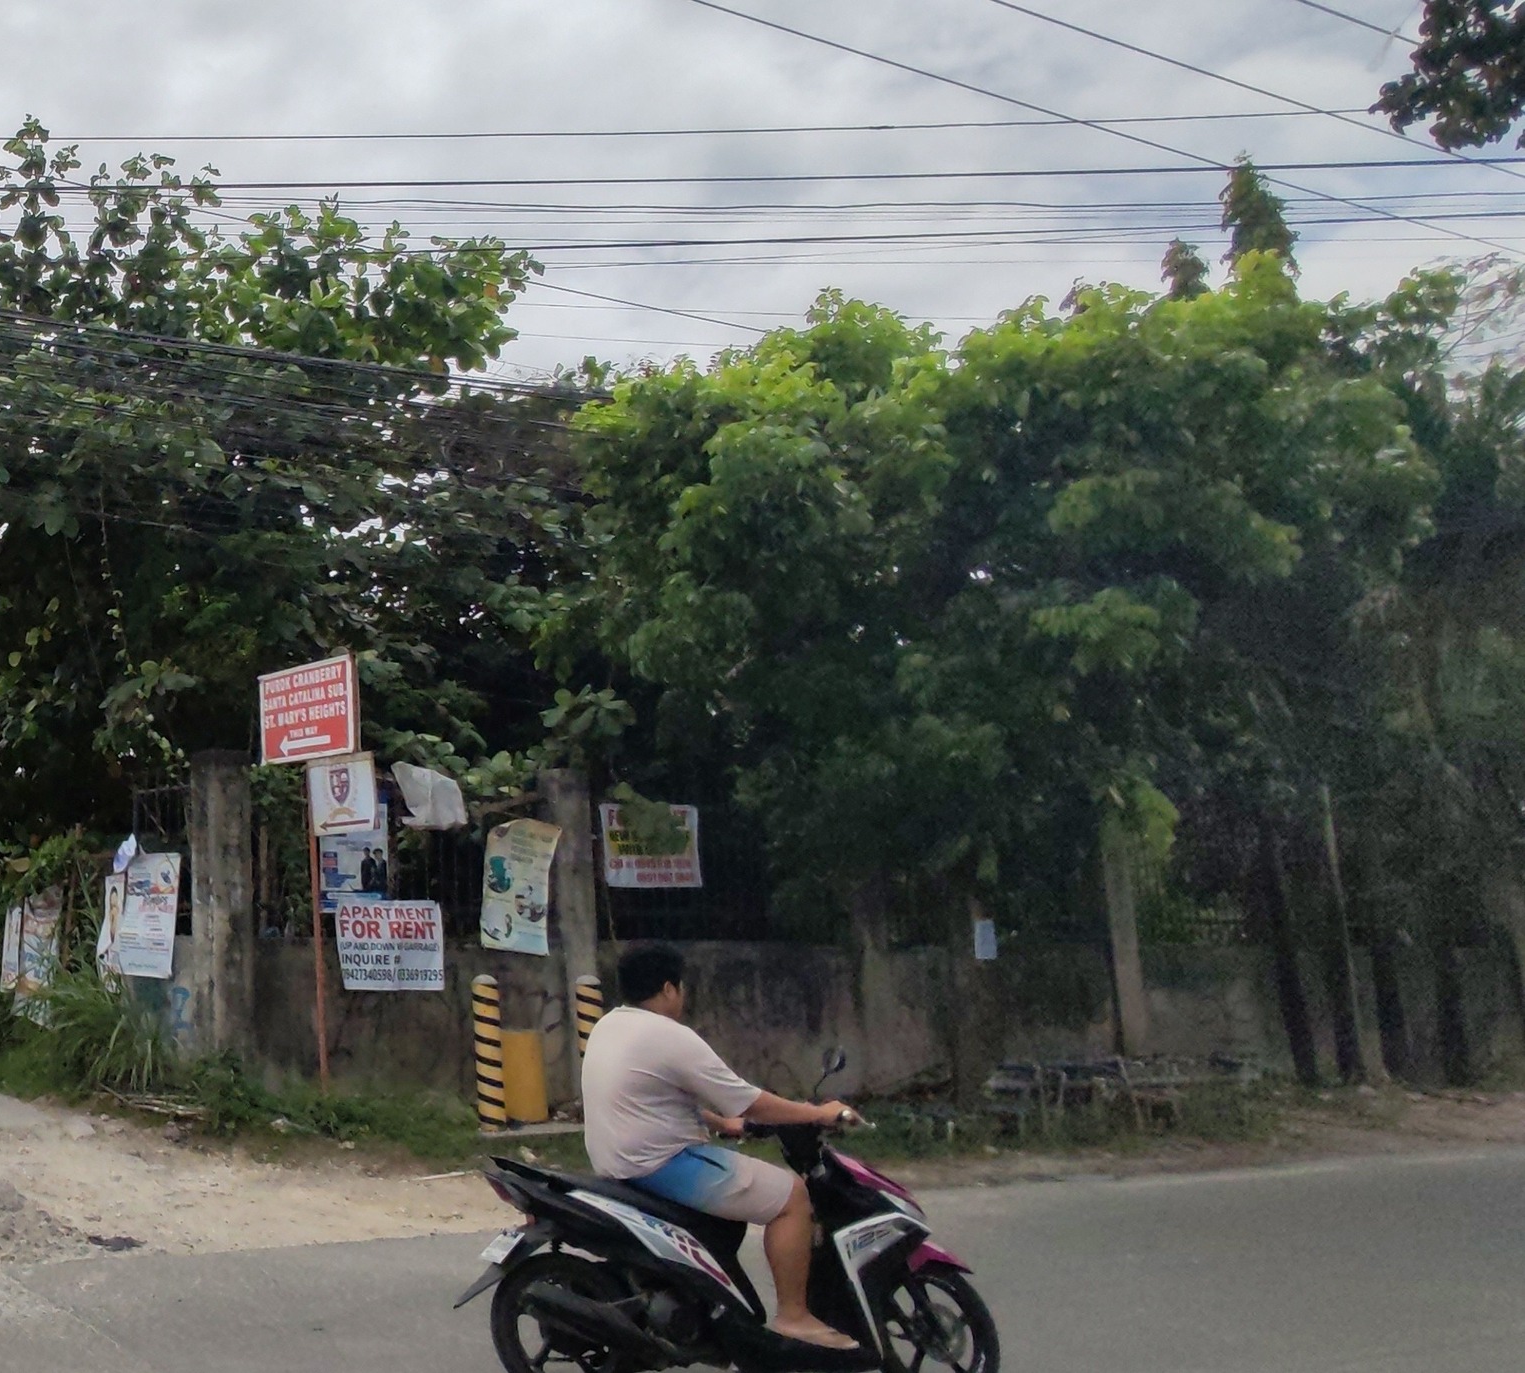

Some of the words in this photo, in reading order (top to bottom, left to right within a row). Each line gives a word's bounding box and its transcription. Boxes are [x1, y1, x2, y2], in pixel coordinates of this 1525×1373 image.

[293, 664, 343, 688] CRANBERRY
[265, 696, 287, 712] SANTA
[289, 687, 326, 706] CATALINA
[278, 708, 306, 727] MARY'S
[309, 701, 346, 721] HEIGHTS
[340, 905, 434, 920] APARTMENT
[339, 920, 382, 940] FOR
[388, 921, 436, 940] RENT
[354, 942, 369, 951] AND
[370, 942, 395, 951] DOWN
[341, 953, 390, 967] INQUIRE
